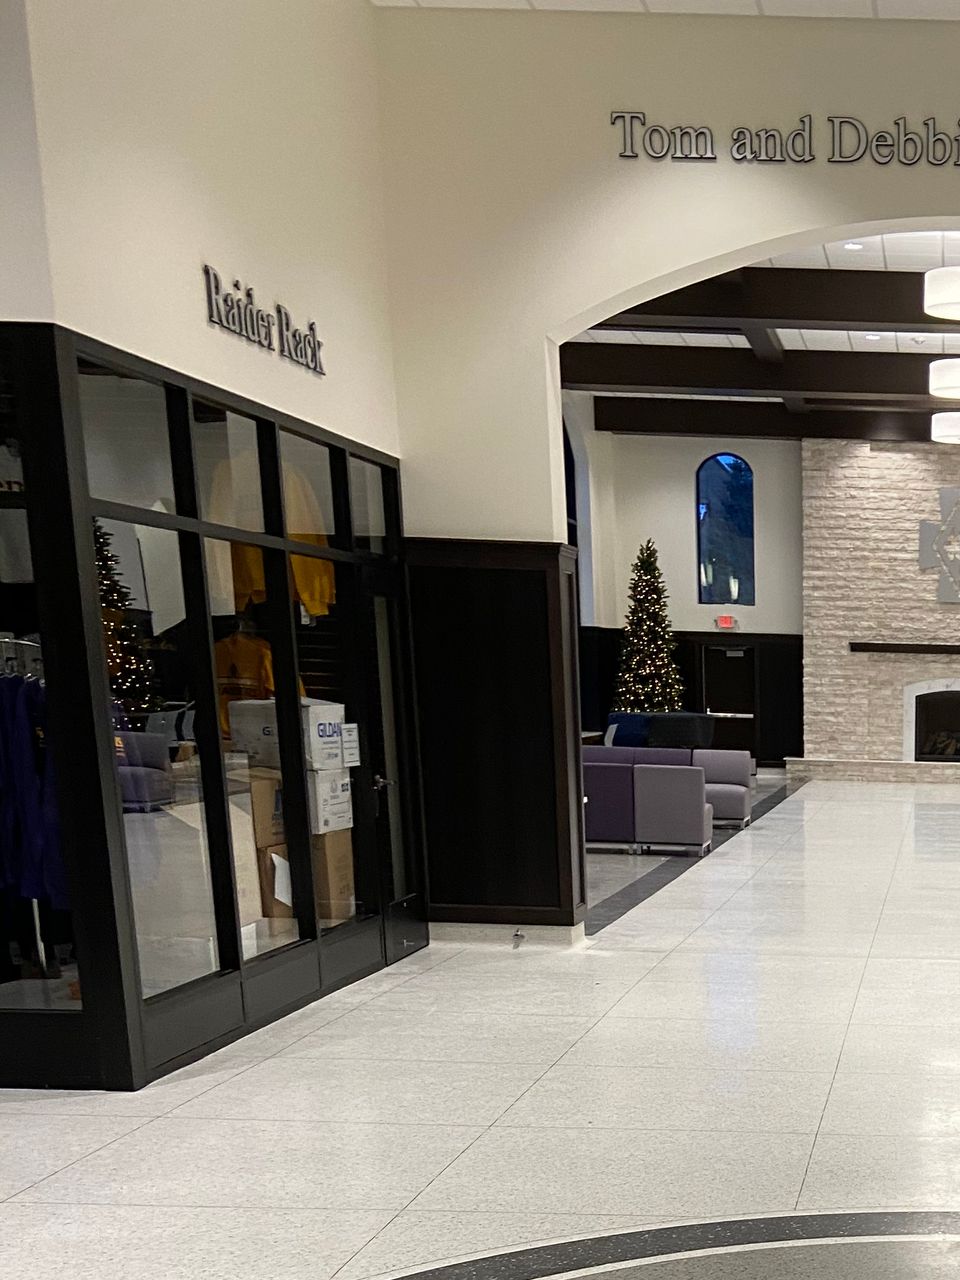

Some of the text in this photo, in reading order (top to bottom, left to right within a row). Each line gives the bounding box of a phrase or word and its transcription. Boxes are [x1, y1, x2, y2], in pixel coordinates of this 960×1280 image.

[610, 111, 716, 159] Tom
[730, 114, 815, 164] and
[204, 264, 326, 376] Raider Rack
